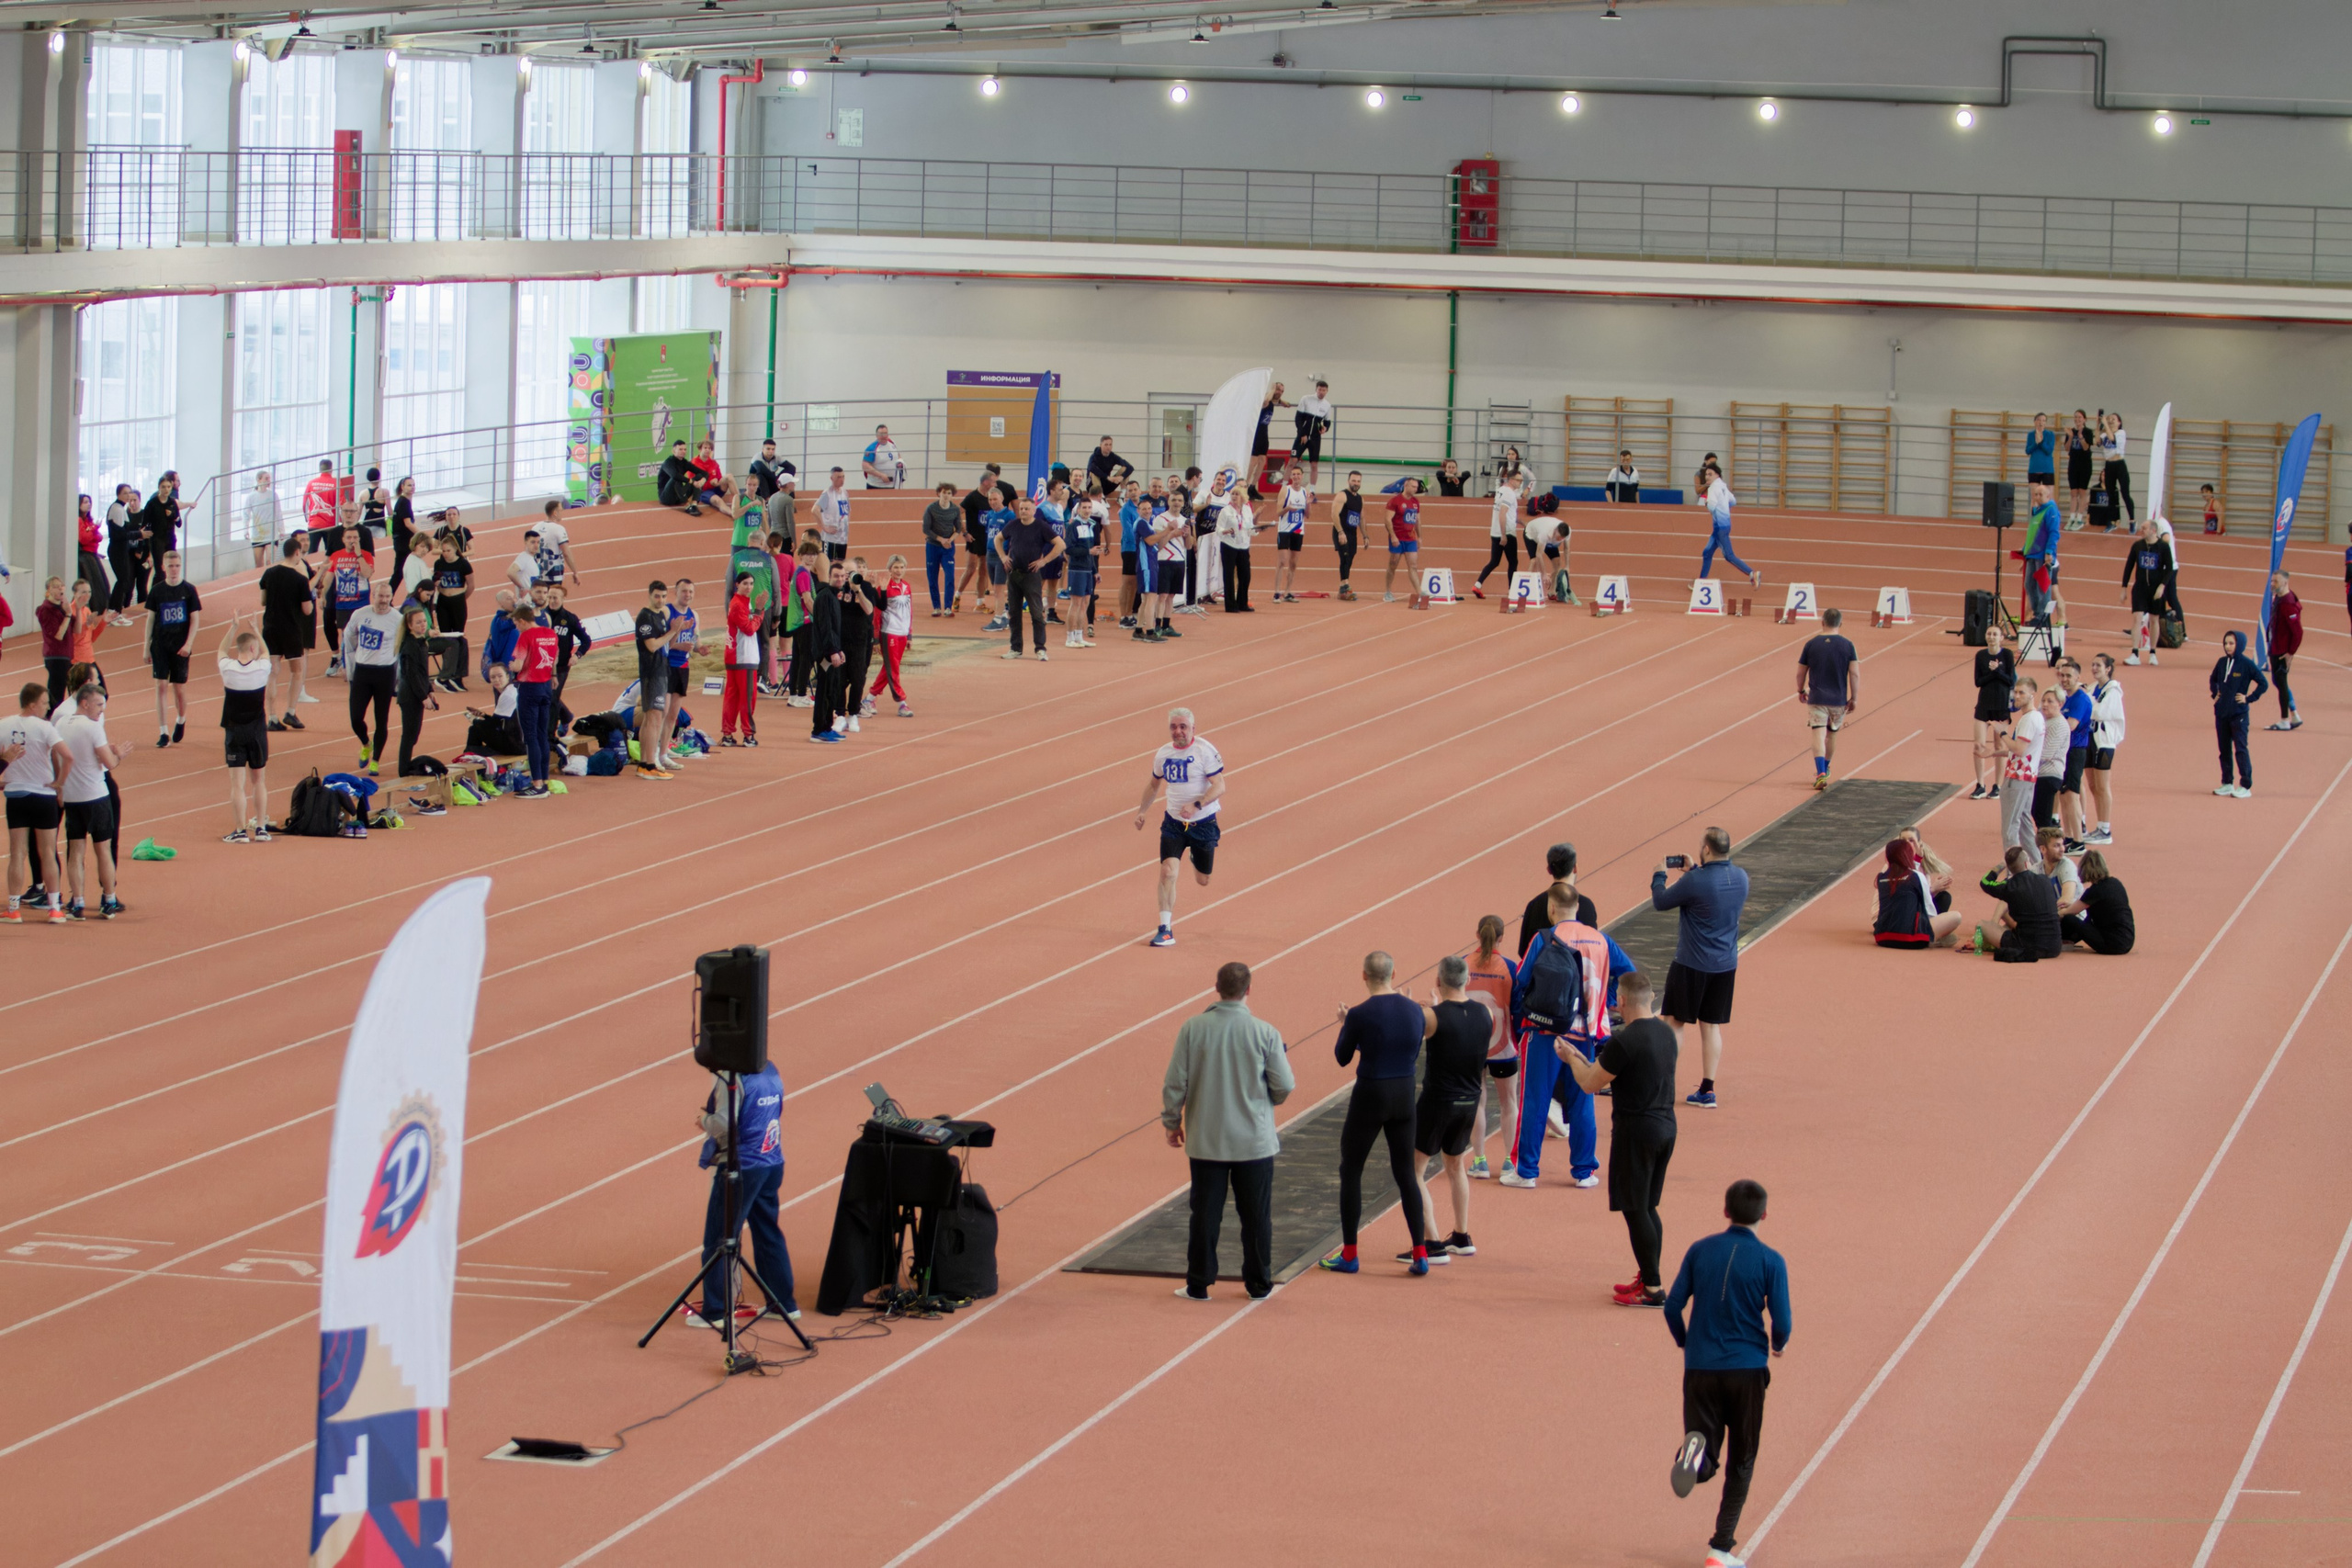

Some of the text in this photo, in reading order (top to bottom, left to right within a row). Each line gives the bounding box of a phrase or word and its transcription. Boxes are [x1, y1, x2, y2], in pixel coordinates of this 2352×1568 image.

[980, 375, 1031, 384] ИНФОРМАЦИЯ
[747, 514, 760, 525] 195
[1291, 512, 1303, 523] 181
[2141, 555, 2155, 567] 136
[340, 581, 356, 594] 246
[1429, 575, 1441, 594] 6
[1518, 579, 1530, 598] 5
[1603, 582, 1617, 603] 4
[1700, 586, 1712, 605] 3
[1794, 590, 1807, 610] 2
[1886, 594, 1895, 614] 1
[164, 606, 184, 622] 038
[360, 631, 379, 648] 123
[1166, 764, 1184, 780] 131
